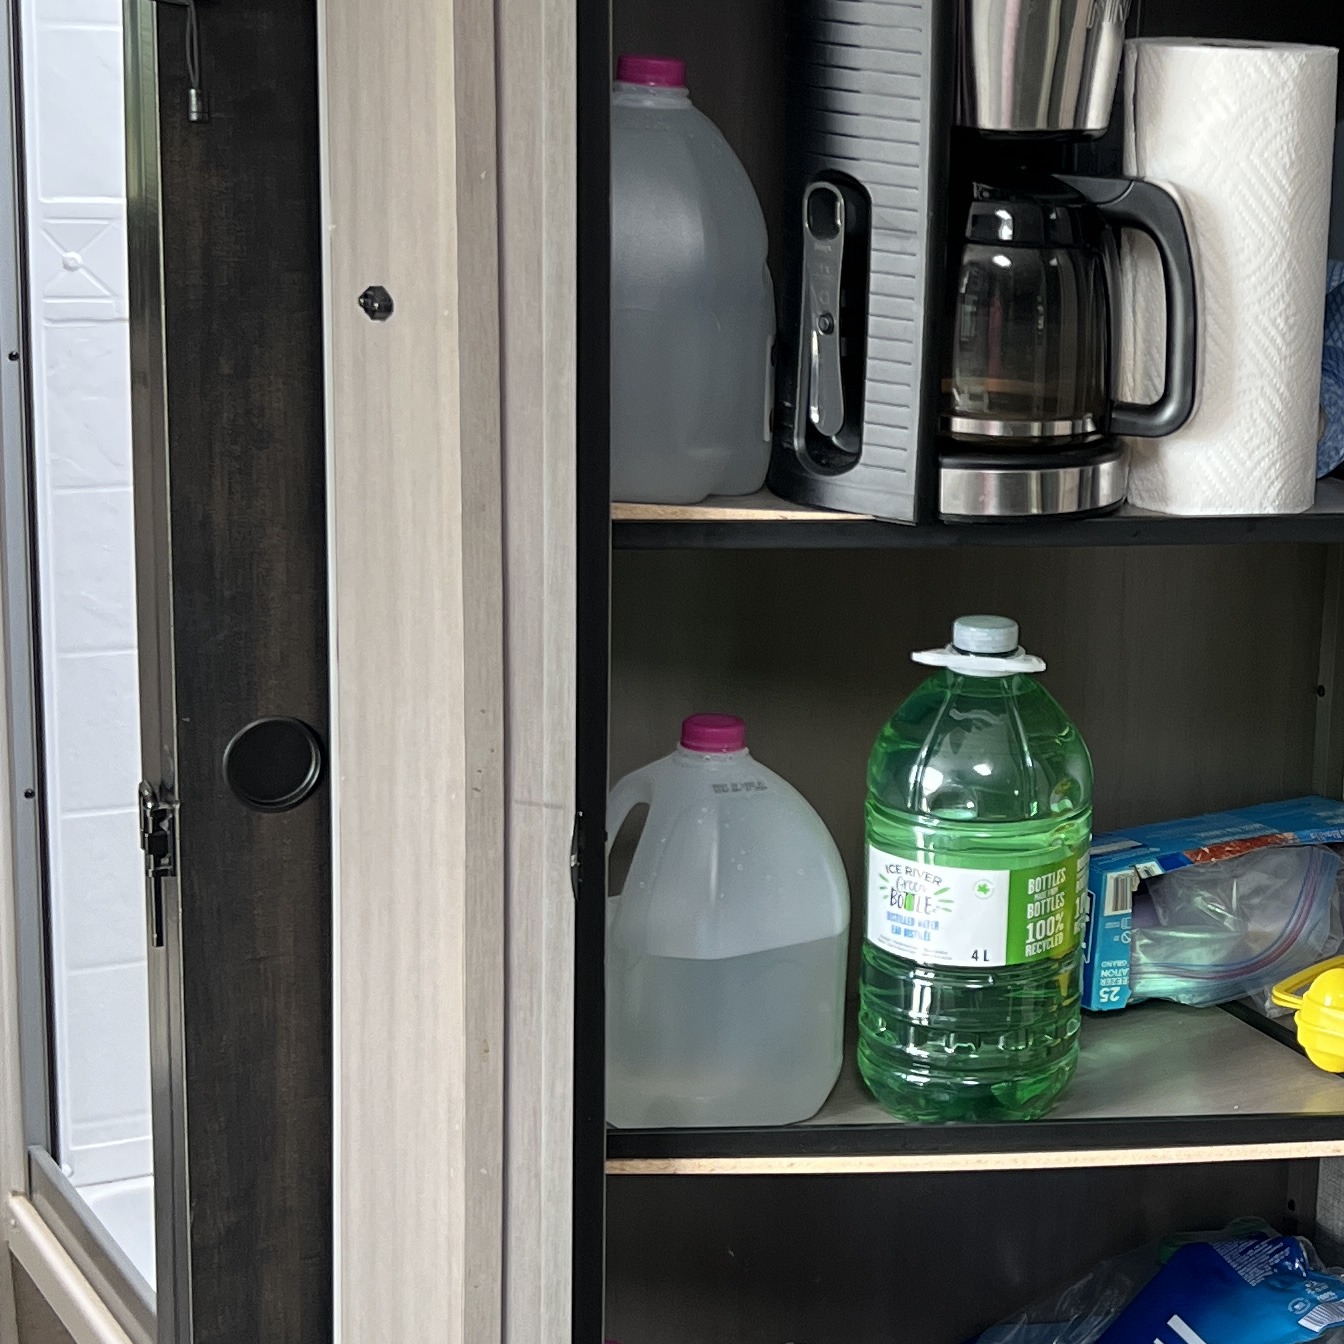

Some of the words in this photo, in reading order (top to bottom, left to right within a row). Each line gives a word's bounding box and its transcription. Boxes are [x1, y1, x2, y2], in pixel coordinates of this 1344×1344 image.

[885, 864, 902, 874] ICE
[905, 865, 943, 887] RIVER
[1028, 867, 1067, 895] BOTTLES
[1027, 892, 1065, 920] BOTTLES
[1026, 911, 1064, 944] 100%
[971, 950, 979, 962] 4
[983, 950, 990, 962] L
[1025, 932, 1064, 957] RECYCLED
[1100, 968, 1129, 977] ATION
[1100, 976, 1129, 987] EEZER
[1099, 986, 1121, 1003] 25
